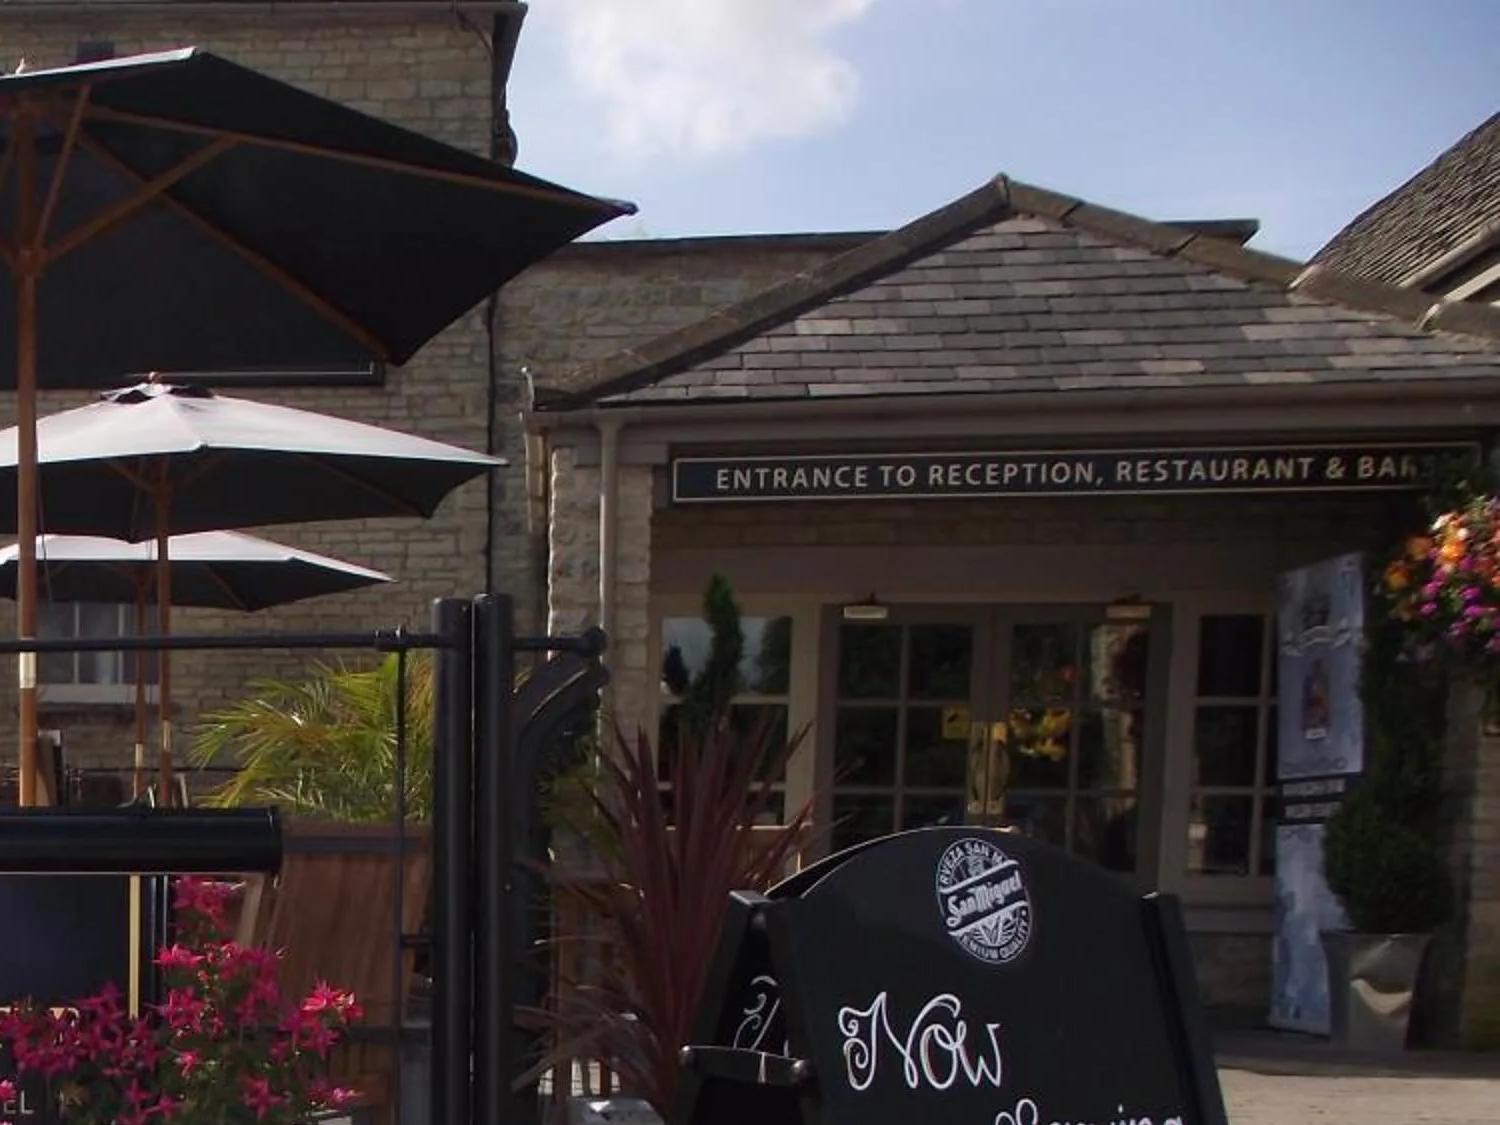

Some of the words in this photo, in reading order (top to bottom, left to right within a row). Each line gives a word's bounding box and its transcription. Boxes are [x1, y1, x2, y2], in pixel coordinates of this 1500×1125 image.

[715, 465, 869, 490] ENTRANCE
[878, 464, 917, 487] TO
[1115, 457, 1316, 483] RESTAURANT
[1325, 456, 1345, 478] &
